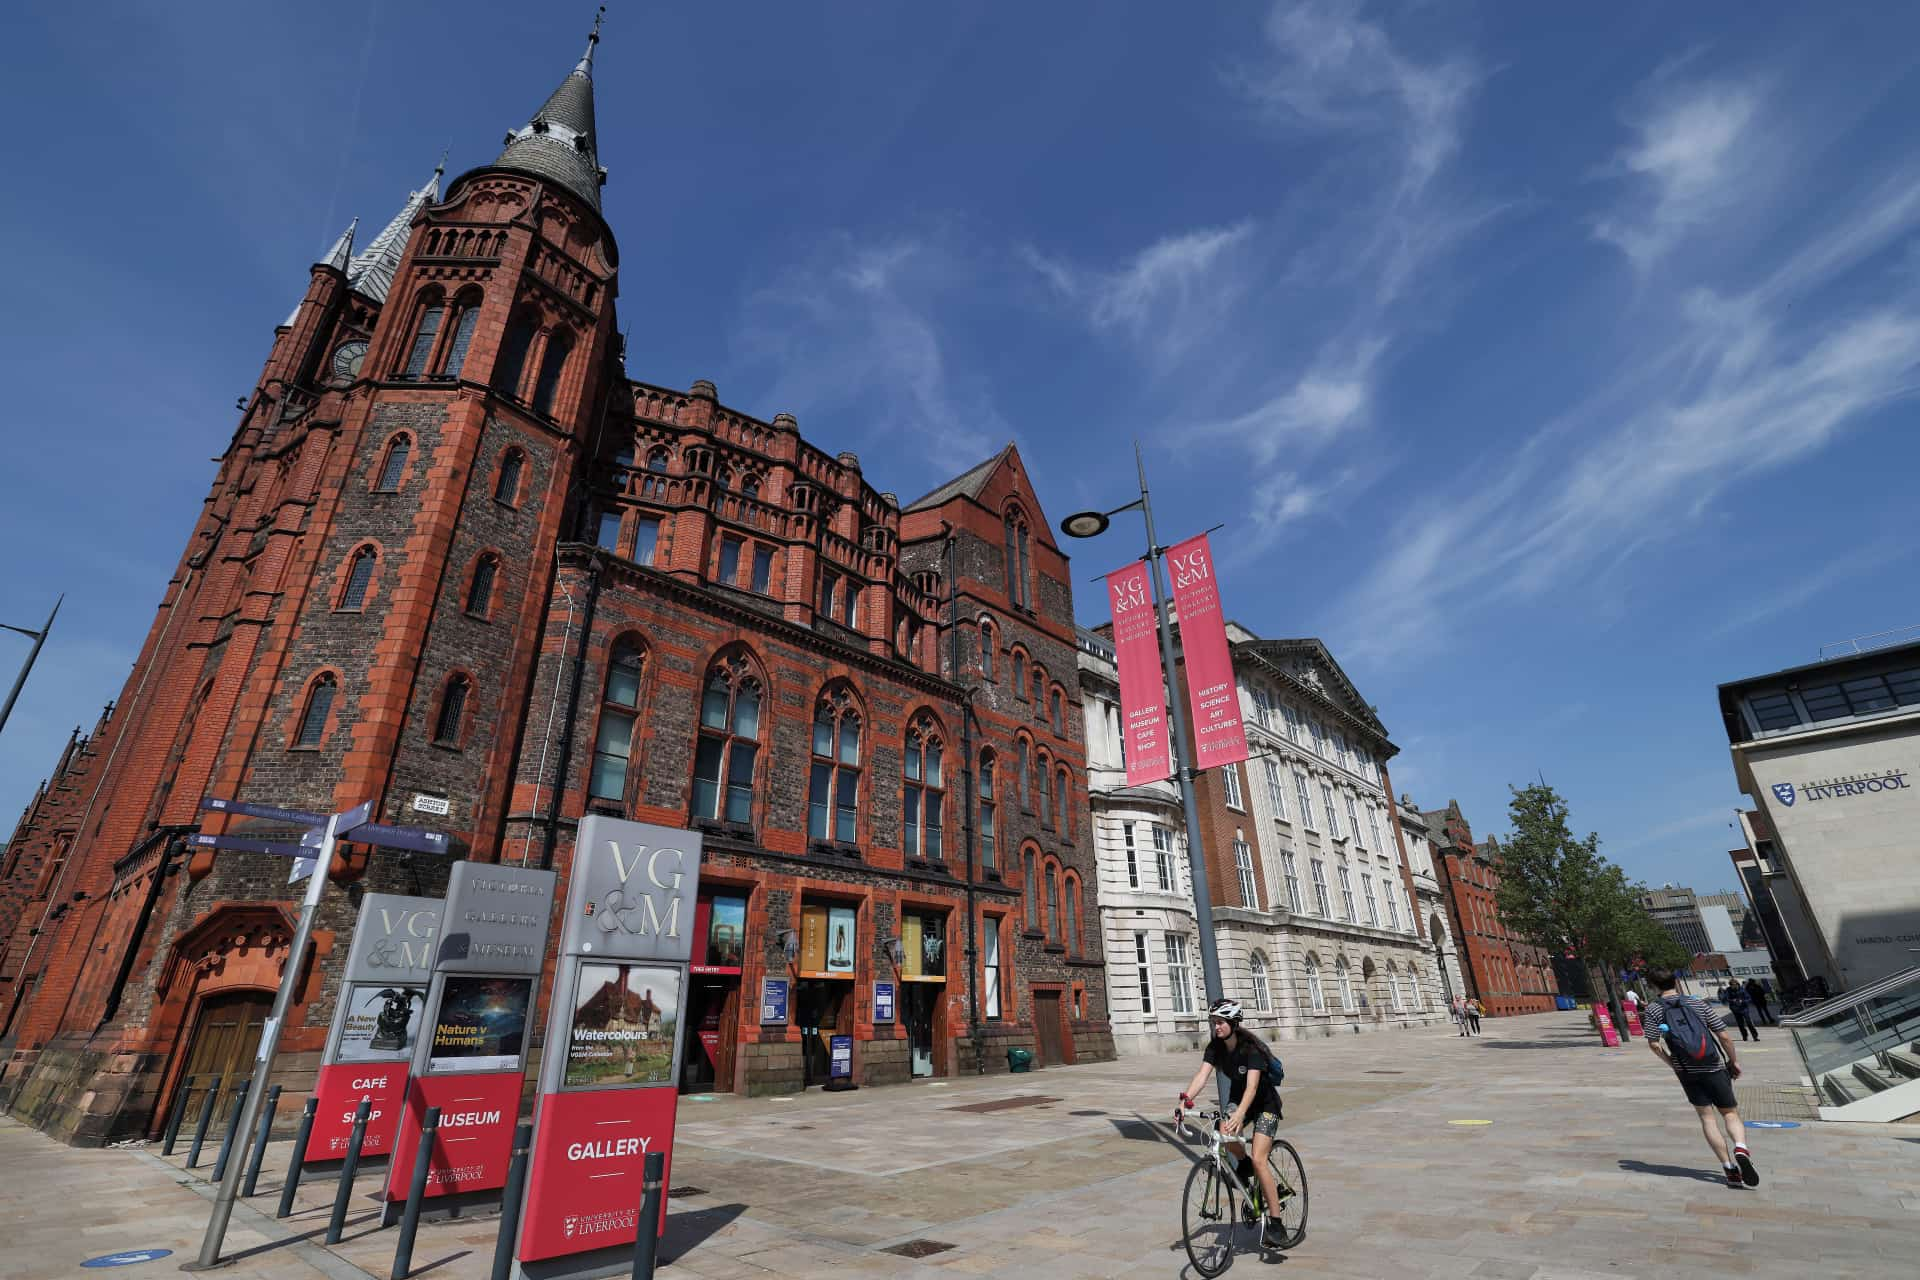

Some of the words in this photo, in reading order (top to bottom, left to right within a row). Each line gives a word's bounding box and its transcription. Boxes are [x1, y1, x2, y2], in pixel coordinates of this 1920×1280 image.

[1173, 548, 1204, 572] VG
[1177, 563, 1208, 588] &M
[1113, 576, 1142, 597] VG
[1115, 590, 1145, 613] &M
[1198, 682, 1228, 697] HISTORY
[1200, 695, 1231, 709] SCIENCE
[1129, 705, 1158, 718] GALLERY
[1210, 709, 1224, 718] ART
[1130, 716, 1160, 729] MUSEUM
[1200, 718, 1238, 734] CULTURES
[1137, 741, 1156, 752] SHOP
[1801, 772, 1878, 788] UNIVERSITY
[1886, 768, 1900, 776] OF
[1804, 776, 1911, 801] LIVERPOOL
[606, 839, 685, 889] VG
[471, 878, 545, 897] VICTORIA
[464, 910, 538, 928] GALLERY
[596, 889, 682, 937] &M
[377, 908, 438, 938] VG
[367, 938, 431, 971] &M
[470, 943, 535, 958] MUSEUM
[348, 1015, 355, 1023] A
[357, 1015, 376, 1023] New
[437, 1024, 477, 1035] Nature
[480, 1026, 488, 1035] v
[574, 1029, 648, 1041] Watercolours
[435, 1036, 485, 1046] Humans
[352, 1075, 388, 1090] CAFÉ
[567, 1136, 652, 1161] GALLERY
[578, 1216, 636, 1236] LIVERPOOL
[579, 1212, 624, 1223] UNIVERSITY
